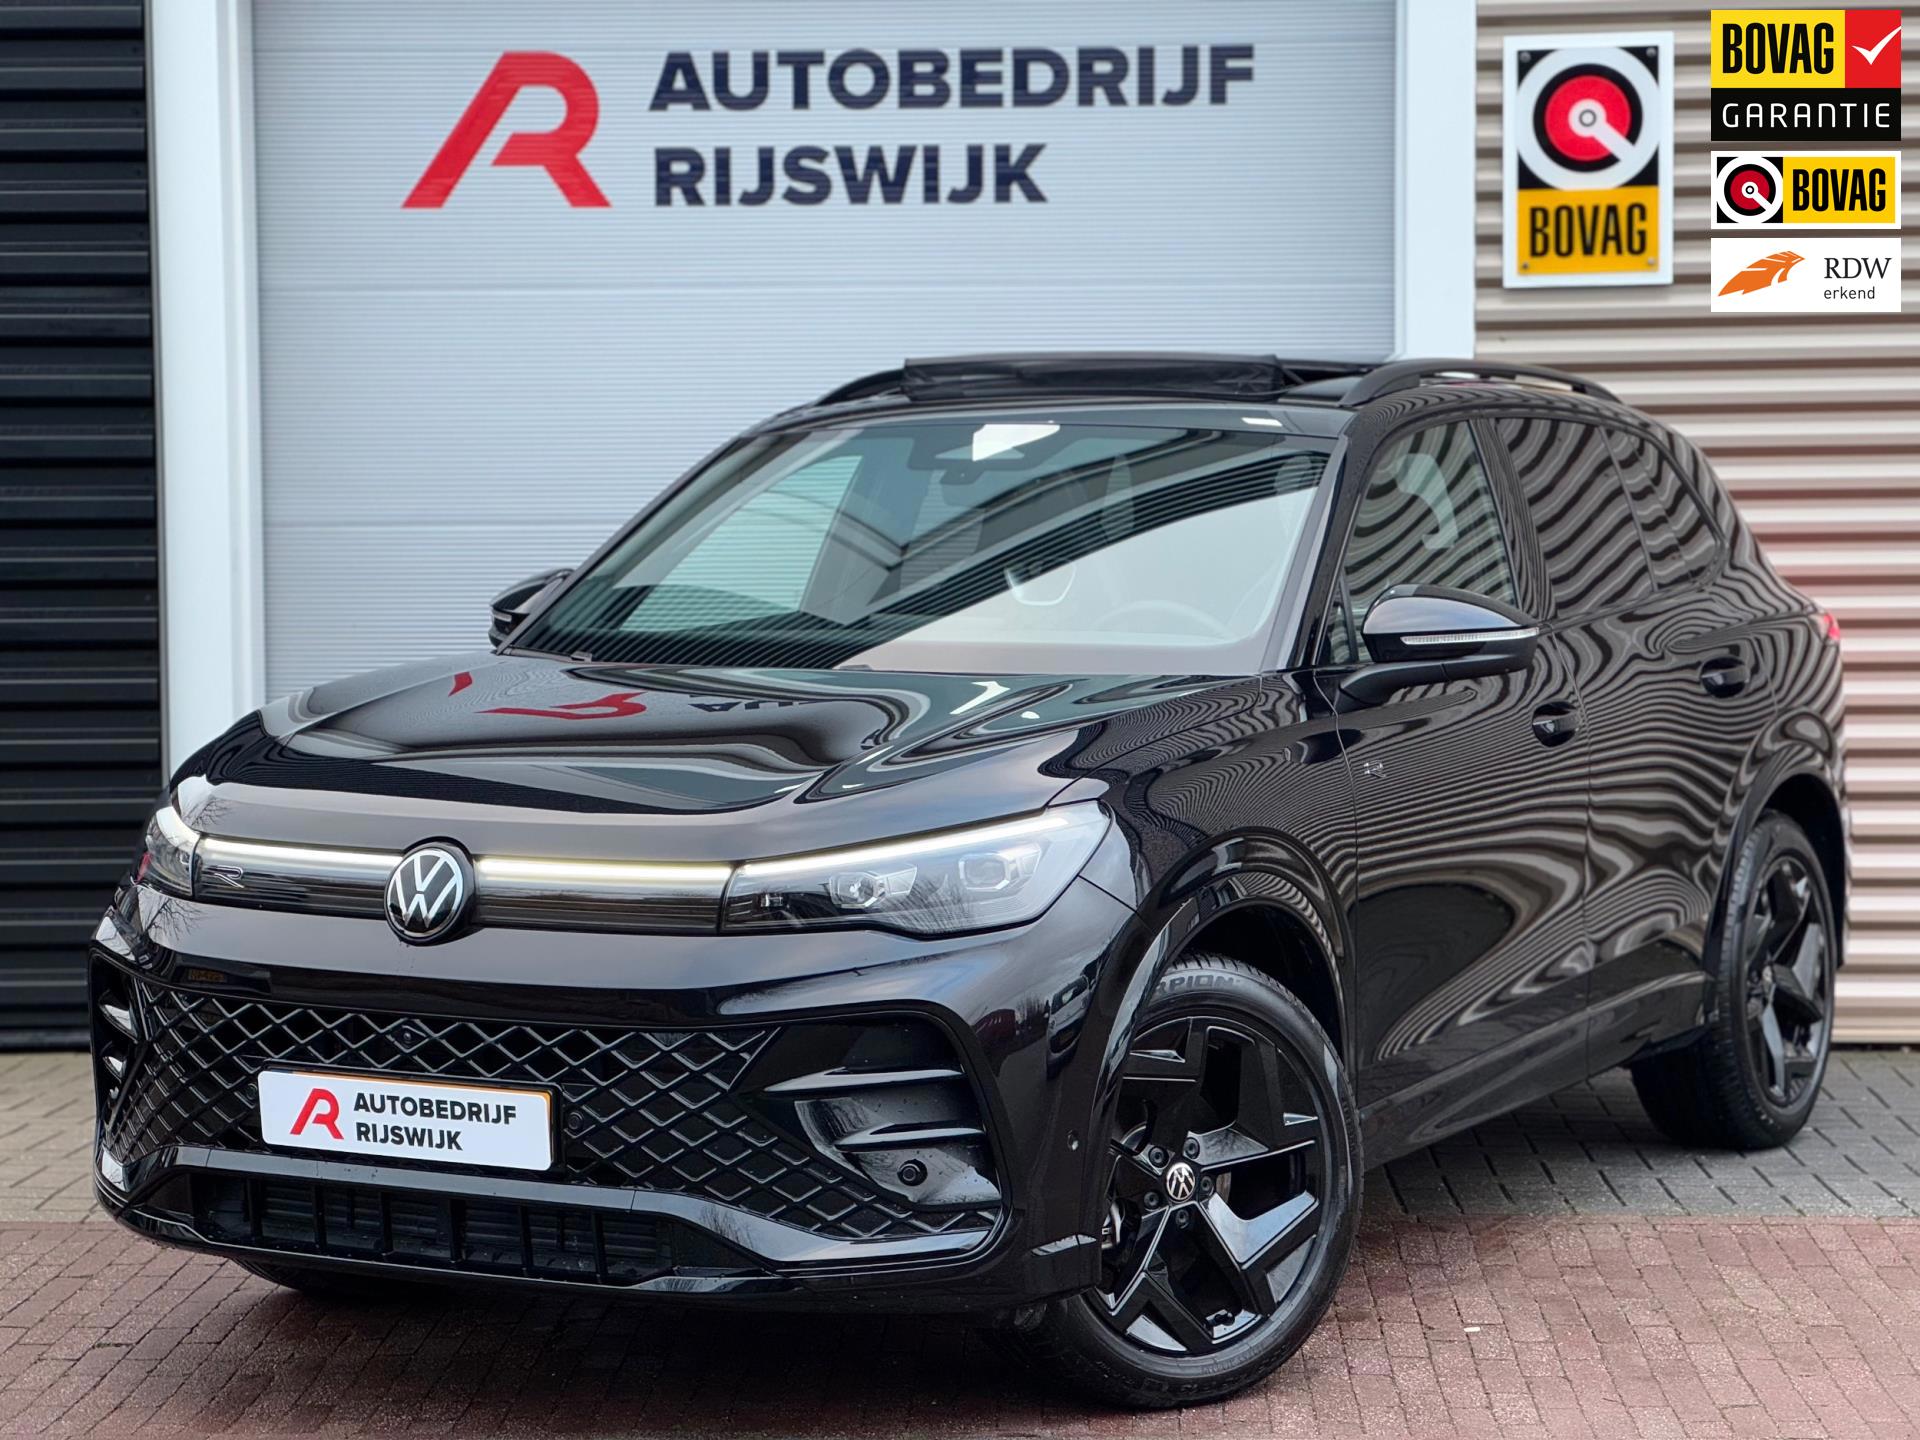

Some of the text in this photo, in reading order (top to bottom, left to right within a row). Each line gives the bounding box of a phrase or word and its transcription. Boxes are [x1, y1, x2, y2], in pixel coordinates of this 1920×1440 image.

[649, 44, 1255, 111] AUTOBEDRIJF
[654, 144, 1048, 207] RIJSWIJK
[1529, 203, 1648, 258] BOVAG
[353, 1092, 516, 1125] AUTOBEDRIJF
[356, 1122, 463, 1151] RIJSWIJK
